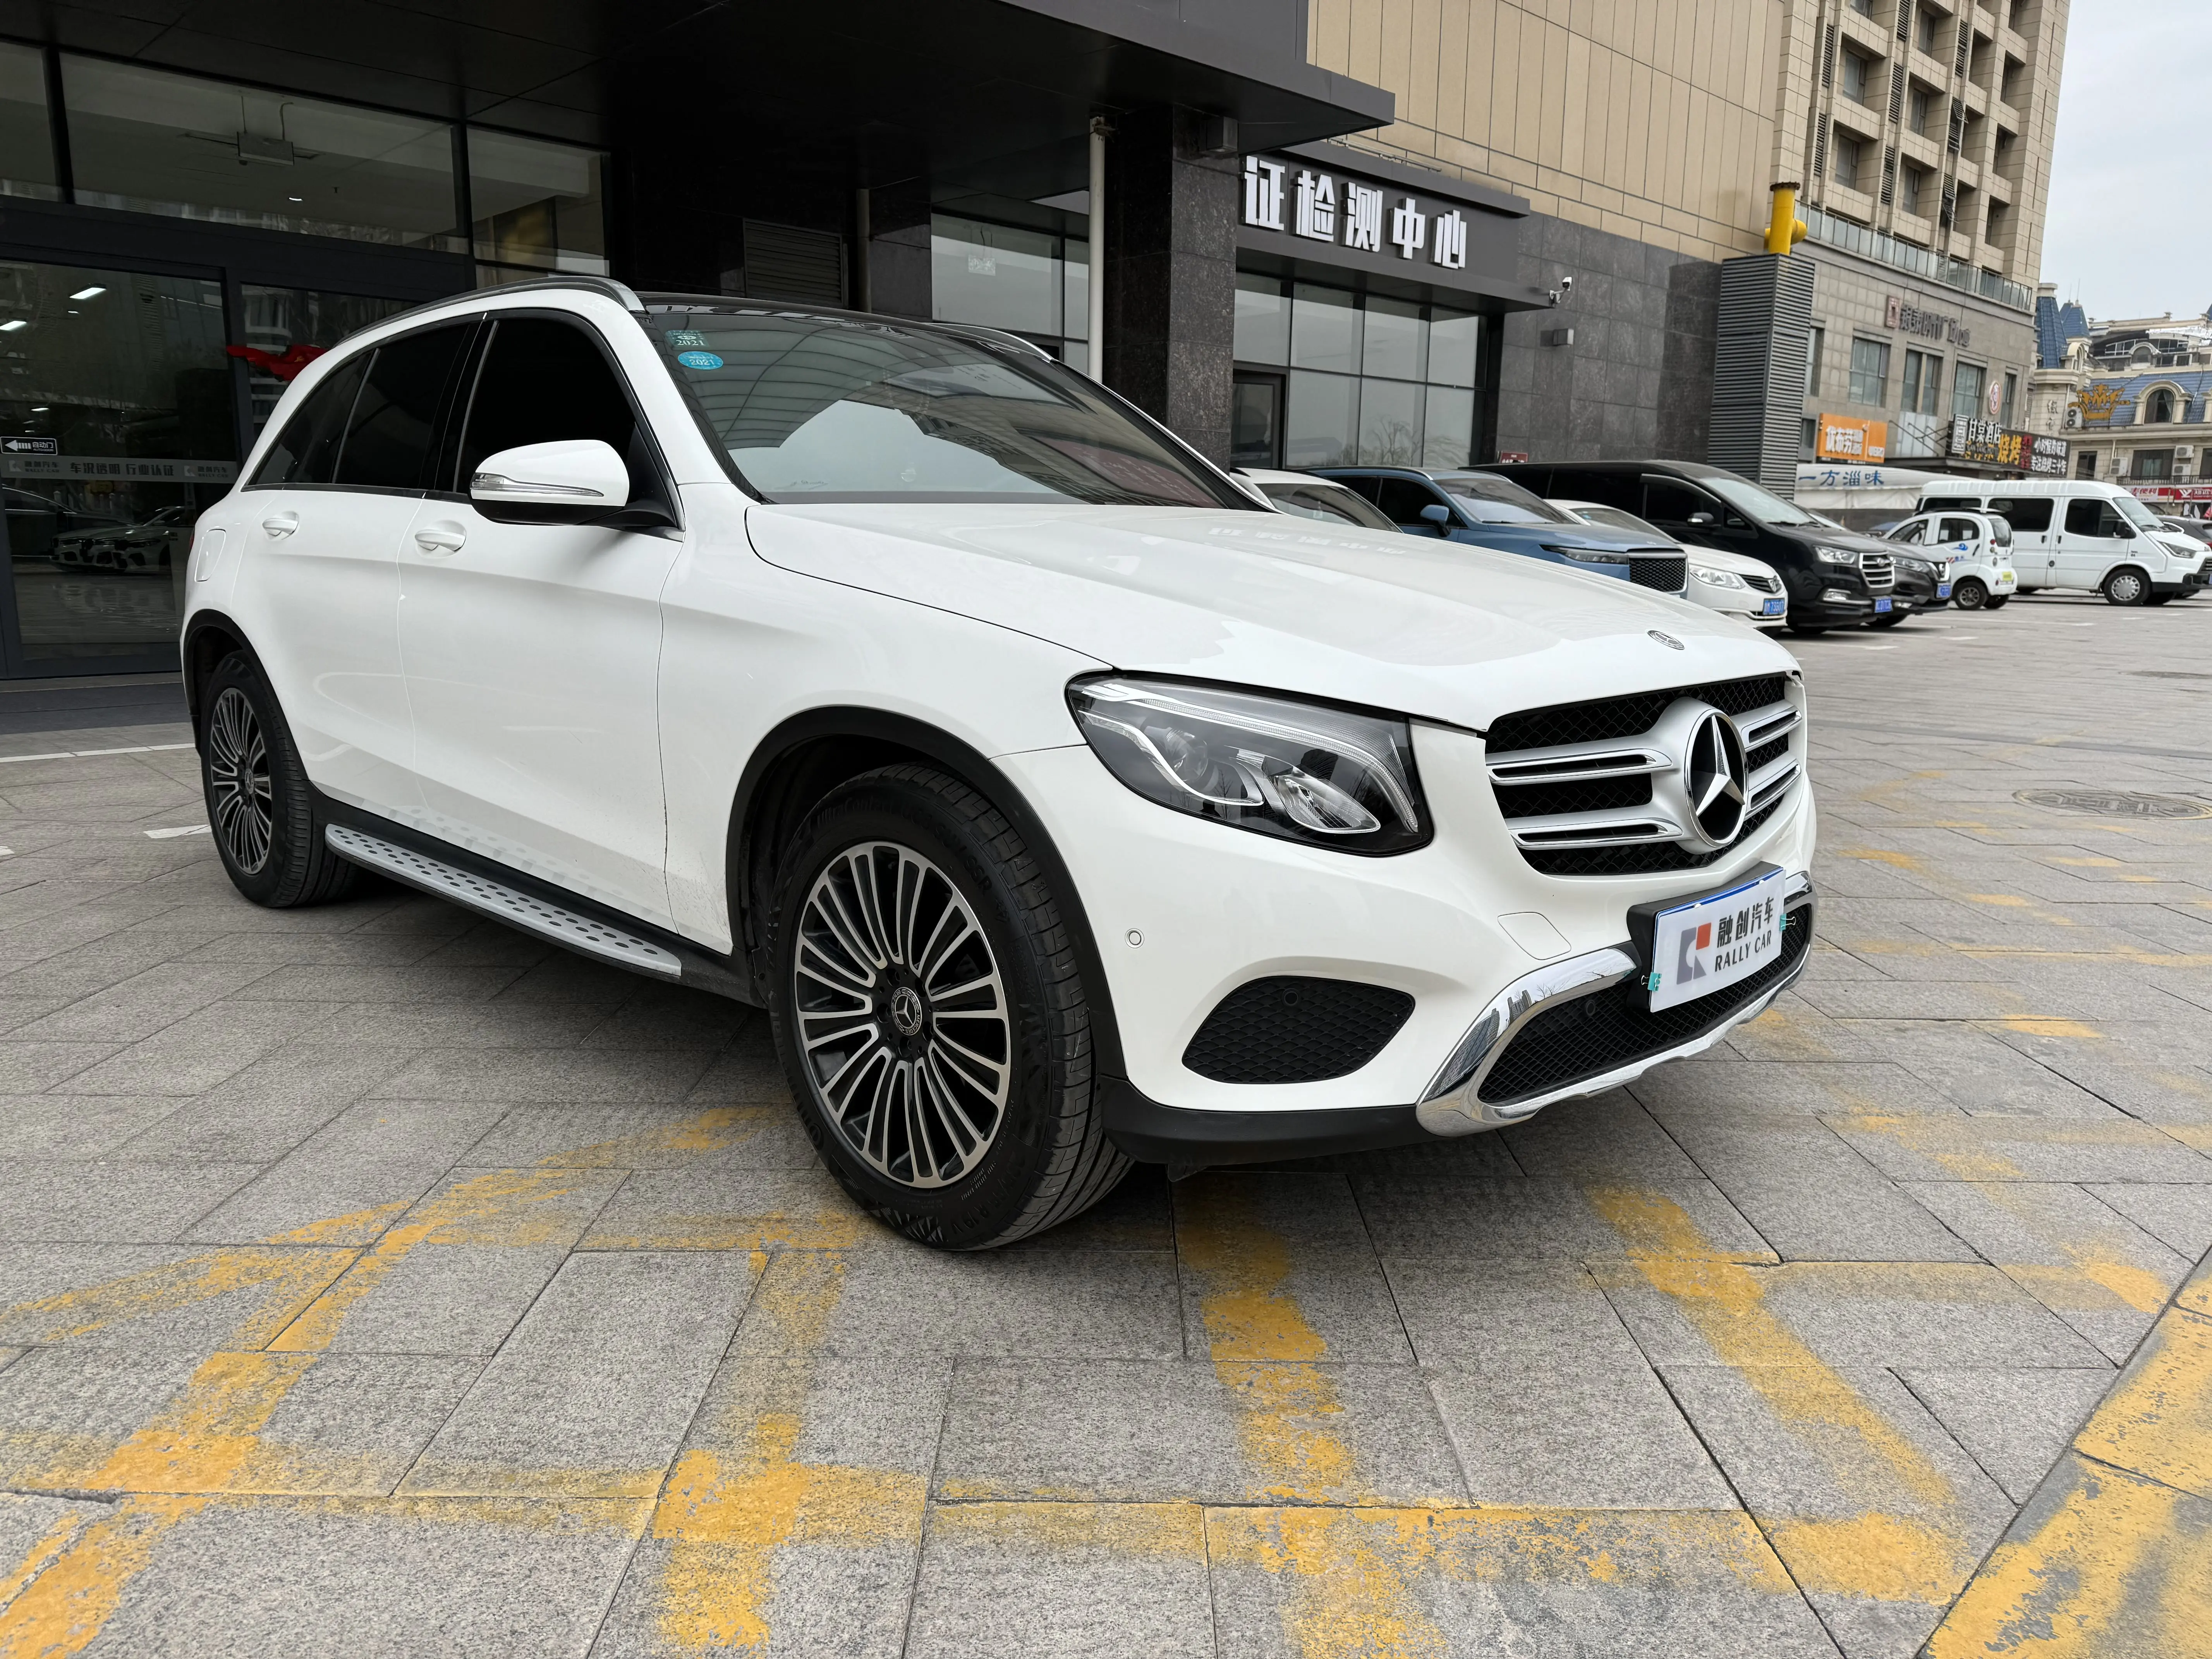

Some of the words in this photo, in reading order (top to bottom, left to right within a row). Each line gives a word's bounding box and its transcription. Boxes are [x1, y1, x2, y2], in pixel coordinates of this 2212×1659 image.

[1243, 156, 1467, 269] 证检测中心
[1997, 434, 2022, 465] 烧烤
[2034, 437, 2067, 457] 小时候的味道
[70, 462, 120, 474] 车况透明
[126, 464, 174, 476] 行业认证
[1798, 470, 1884, 486] 一方淄味
[1717, 896, 1774, 948] 融创汽车
[1714, 941, 1751, 972] RALLY
[1755, 930, 1772, 954] CAR
[905, 1014, 921, 1034] MERCEDES
